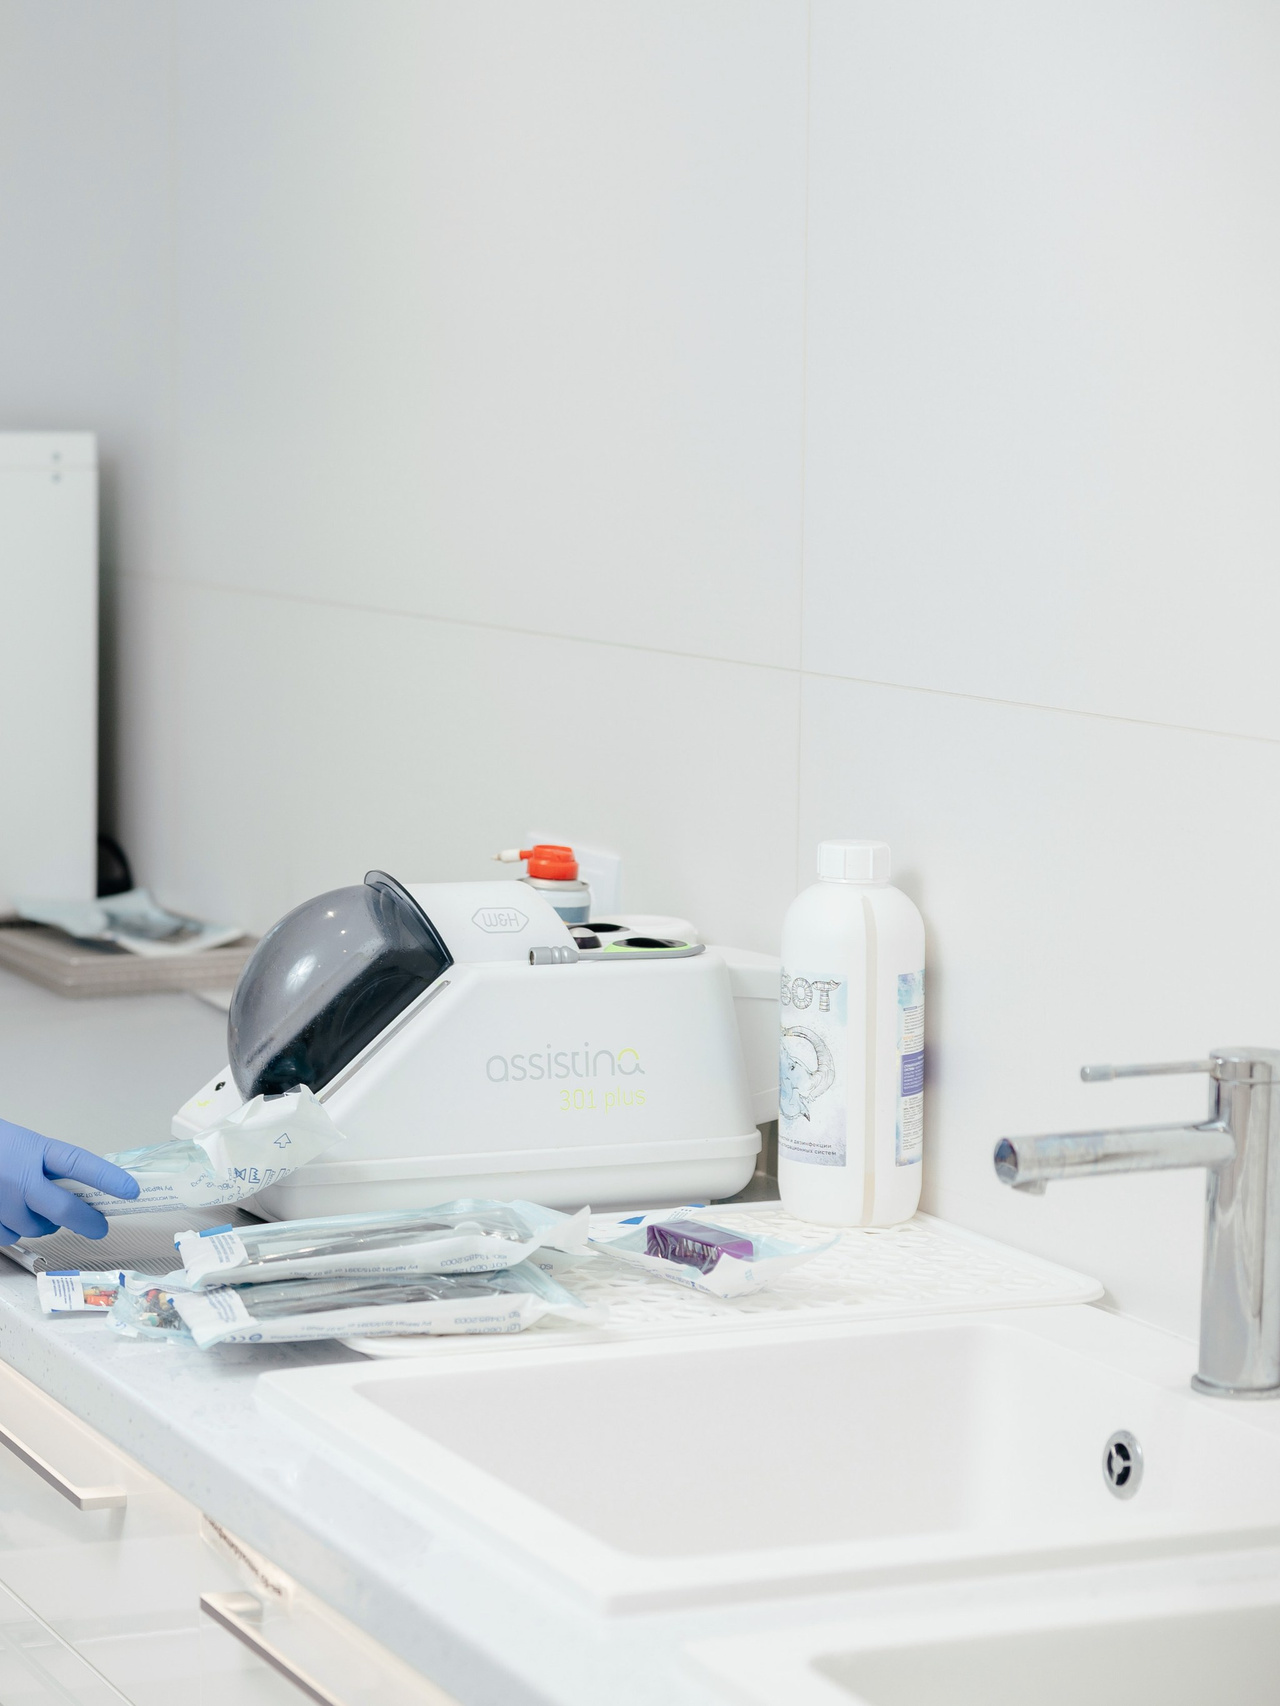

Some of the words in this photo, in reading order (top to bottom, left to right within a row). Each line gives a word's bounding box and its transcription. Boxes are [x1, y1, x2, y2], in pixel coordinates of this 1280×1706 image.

[481, 912, 519, 927] W&H
[486, 1042, 646, 1083] assistina
[559, 1088, 597, 1111] 301
[605, 1087, 647, 1115] plus
